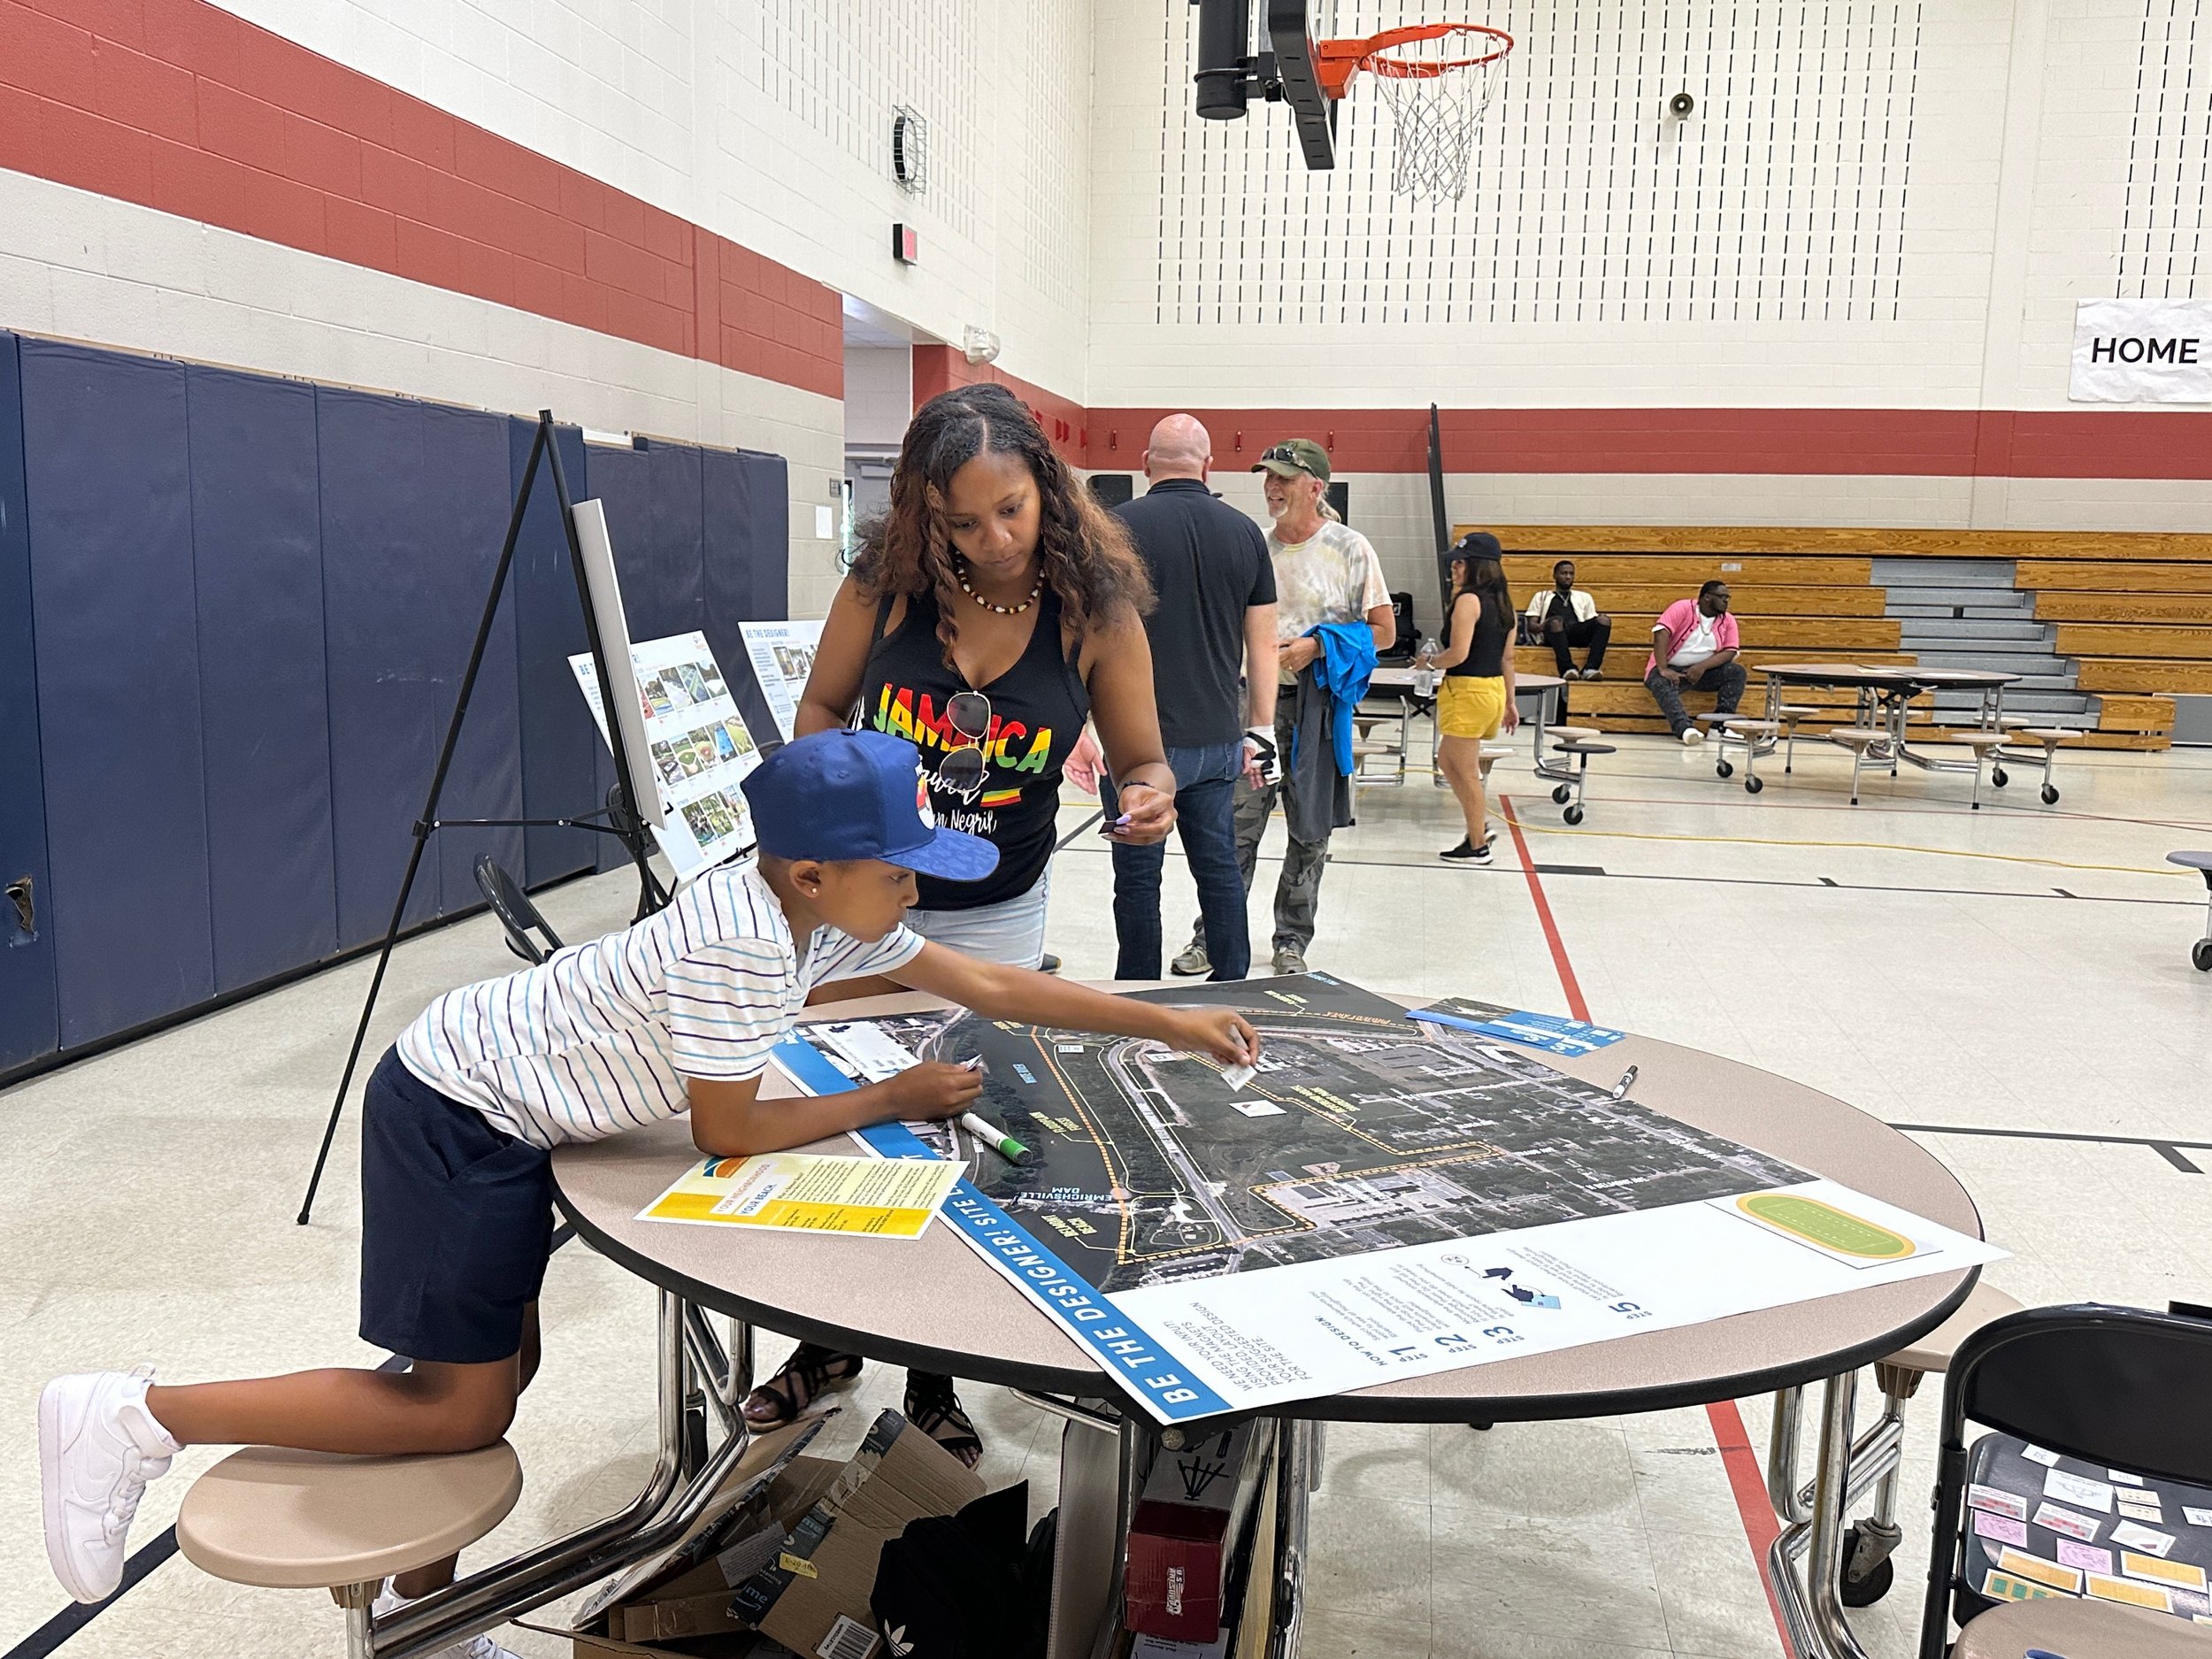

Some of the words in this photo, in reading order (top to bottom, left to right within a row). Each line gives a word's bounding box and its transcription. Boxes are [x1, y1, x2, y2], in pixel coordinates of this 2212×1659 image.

[2092, 337, 2200, 364] HOME
[1019, 1191, 1110, 1201] EMRICHSVILLE
[715, 1200, 735, 1211] YOUR
[738, 1201, 761, 1214] YOUR
[950, 1198, 1000, 1226] SITE
[982, 1228, 1108, 1322] DESIGNER!
[1188, 1302, 1225, 1325] DESIGN
[1606, 1301, 1643, 1313] 5
[1179, 1321, 1225, 1352] MAGNETS
[1200, 1324, 1239, 1349] LAYOUT
[1479, 1325, 1517, 1338] 3
[1493, 1334, 1525, 1344] STEP
[1090, 1325, 1160, 1368] THE
[1217, 1325, 1273, 1363] SUGGESTED
[1248, 1335, 1277, 1351] SITE.
[1347, 1340, 1365, 1349] TO
[1431, 1333, 1469, 1347] 2
[1186, 1340, 1217, 1360] YOUR
[1386, 1345, 1420, 1356] 1
[1445, 1343, 1478, 1353] STEP
[1217, 1352, 1241, 1366] THE
[1269, 1351, 1294, 1365] THE
[1360, 1349, 1387, 1365] HOW
[1396, 1353, 1429, 1362] STEP
[1209, 1360, 1240, 1379] NEED
[1234, 1365, 1269, 1387] USING
[1265, 1363, 1298, 1382] YOUR
[1286, 1365, 1313, 1379] FOR
[1143, 1372, 1199, 1403] BE
[1232, 1379, 1254, 1390] WE
